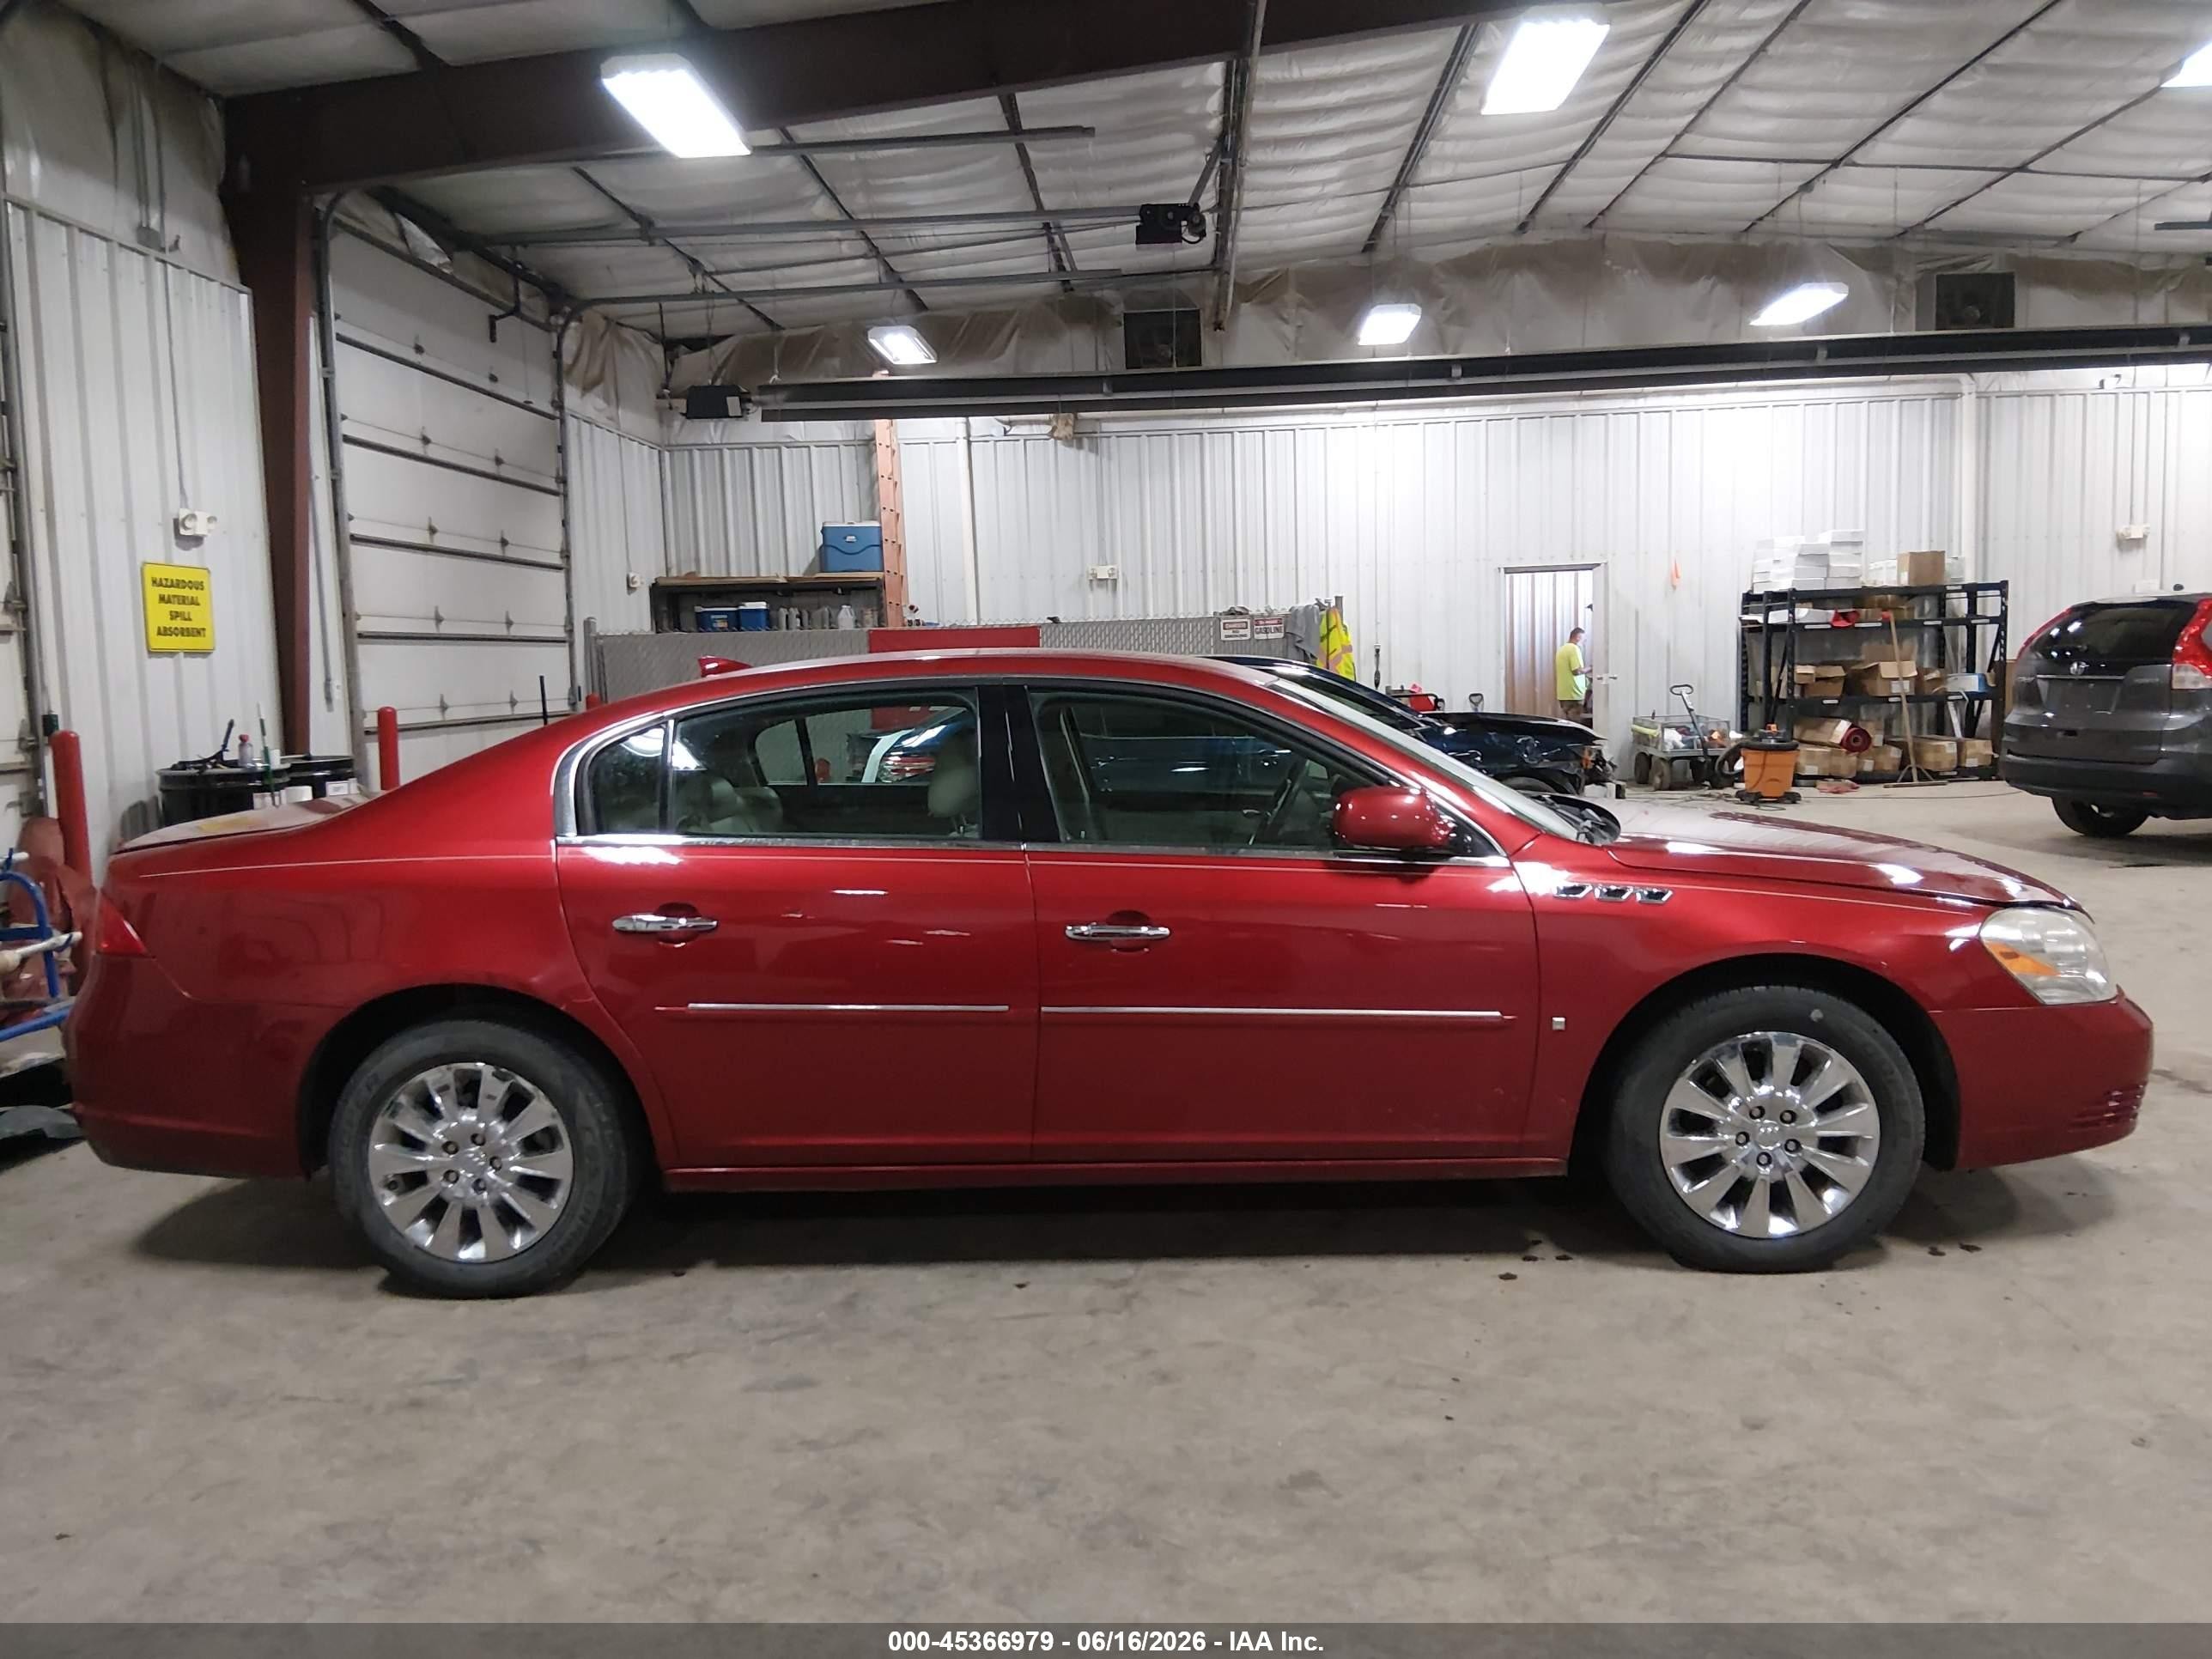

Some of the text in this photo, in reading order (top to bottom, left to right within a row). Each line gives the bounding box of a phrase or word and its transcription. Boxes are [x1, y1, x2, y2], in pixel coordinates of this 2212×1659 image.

[151, 577, 204, 591] HAZARDOUS
[158, 593, 200, 605] MATERIAL
[169, 611, 192, 621] SPILL
[156, 626, 206, 637] ABSORBENT
[1255, 626, 1283, 635] GASOLINE
